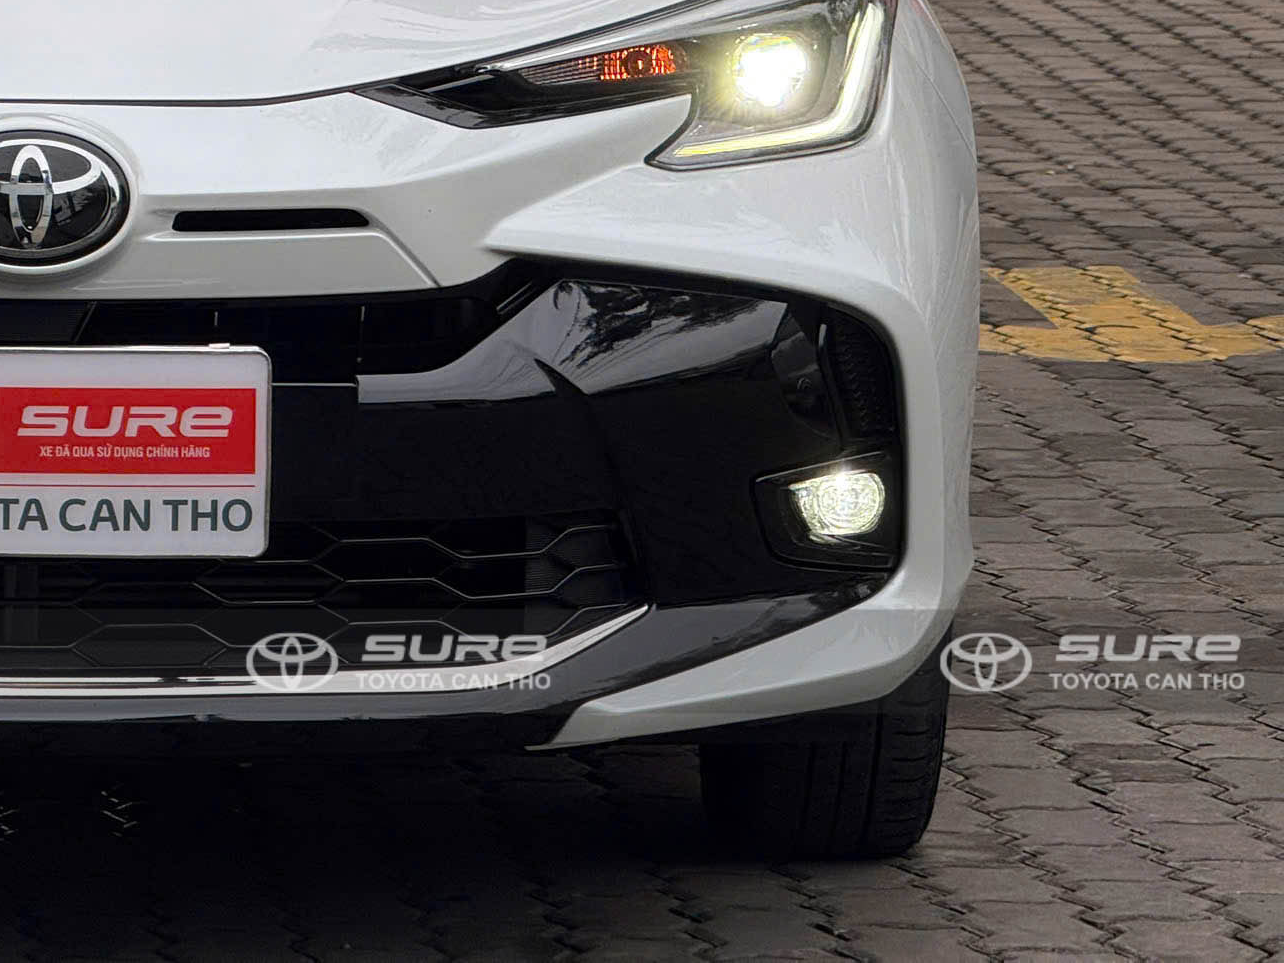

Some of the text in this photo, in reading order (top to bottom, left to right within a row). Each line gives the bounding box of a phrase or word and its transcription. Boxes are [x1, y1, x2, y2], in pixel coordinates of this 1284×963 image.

[39, 446, 53, 457] XE
[72, 446, 94, 458] QUA
[58, 498, 151, 533] CAN
[162, 499, 254, 533] THO
